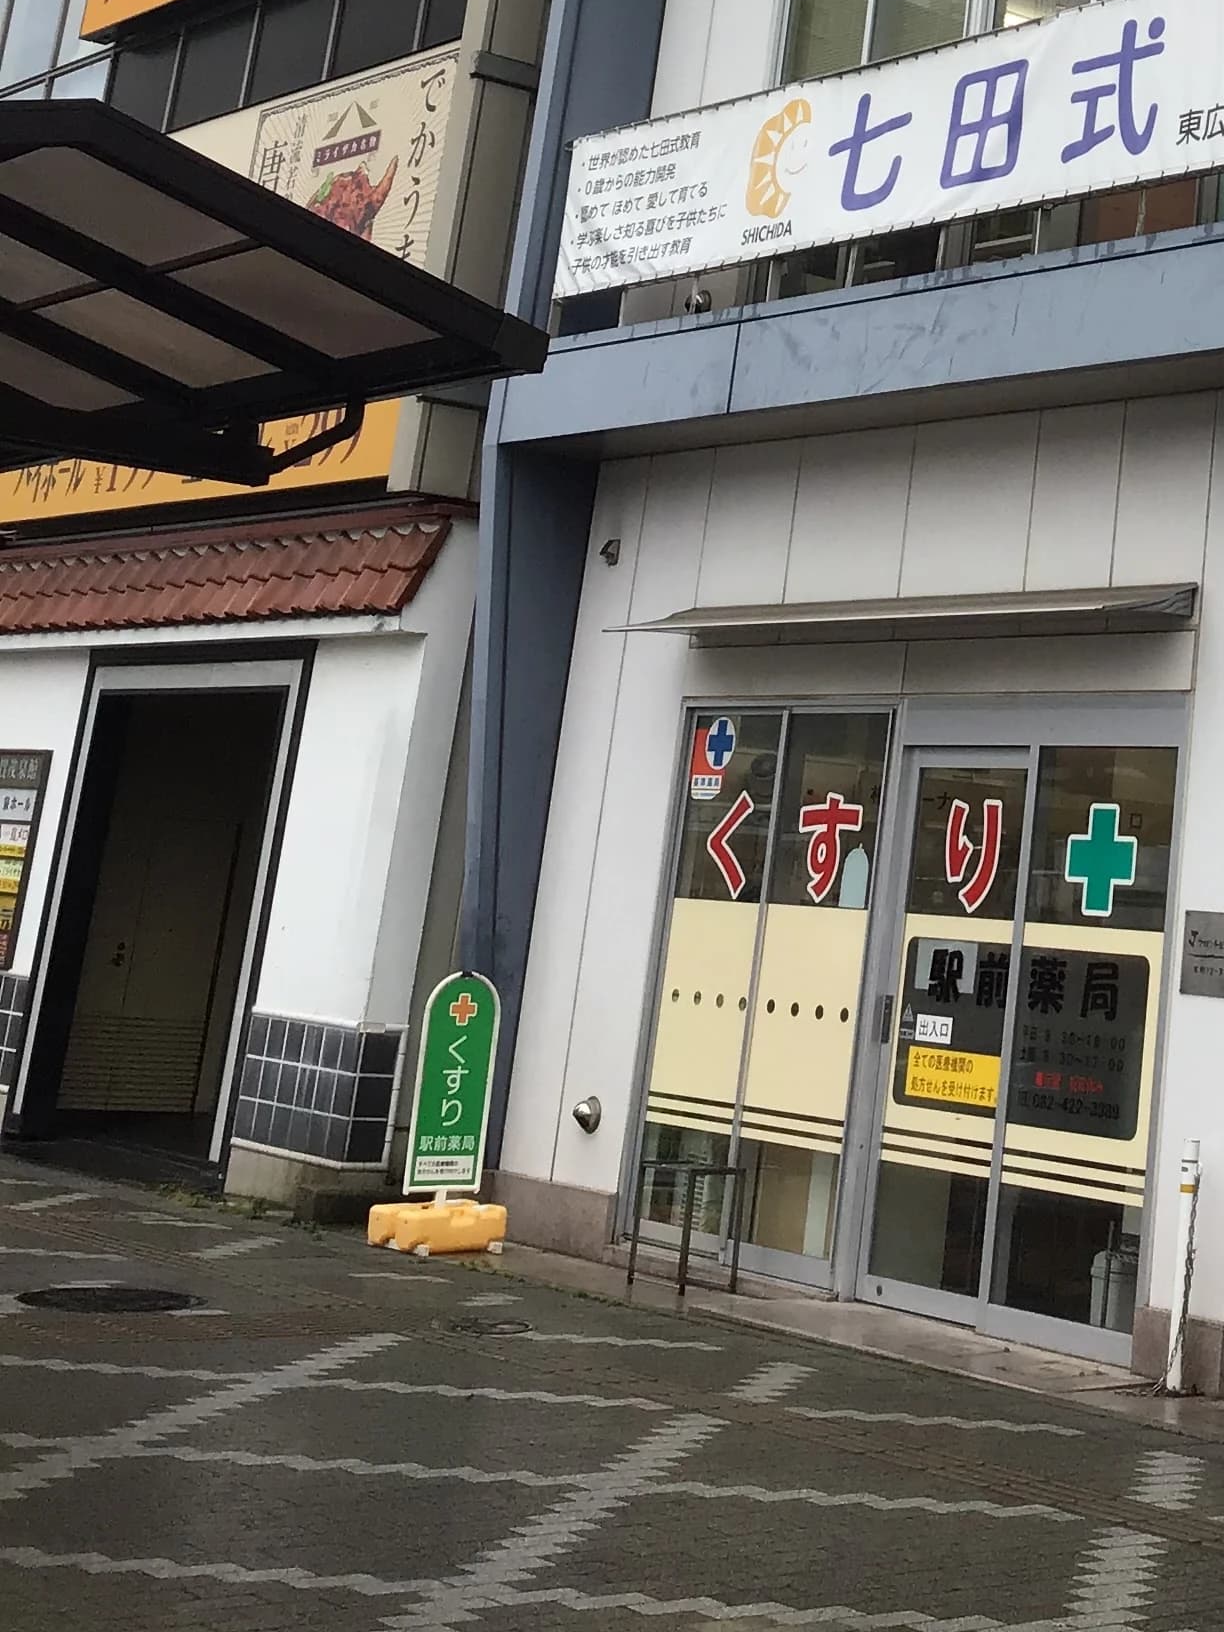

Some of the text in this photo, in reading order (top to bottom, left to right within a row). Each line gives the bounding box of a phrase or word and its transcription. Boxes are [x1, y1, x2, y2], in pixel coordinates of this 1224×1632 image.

[828, 16, 1166, 212] 七田式
[740, 219, 793, 247] SHICHIDA
[706, 789, 1004, 914] くすり
[928, 949, 1121, 1022] 駅前薬局
[919, 1020, 950, 1038] 出入口
[441, 1035, 470, 1126] くすり
[418, 1136, 475, 1152] 駅前薬局
